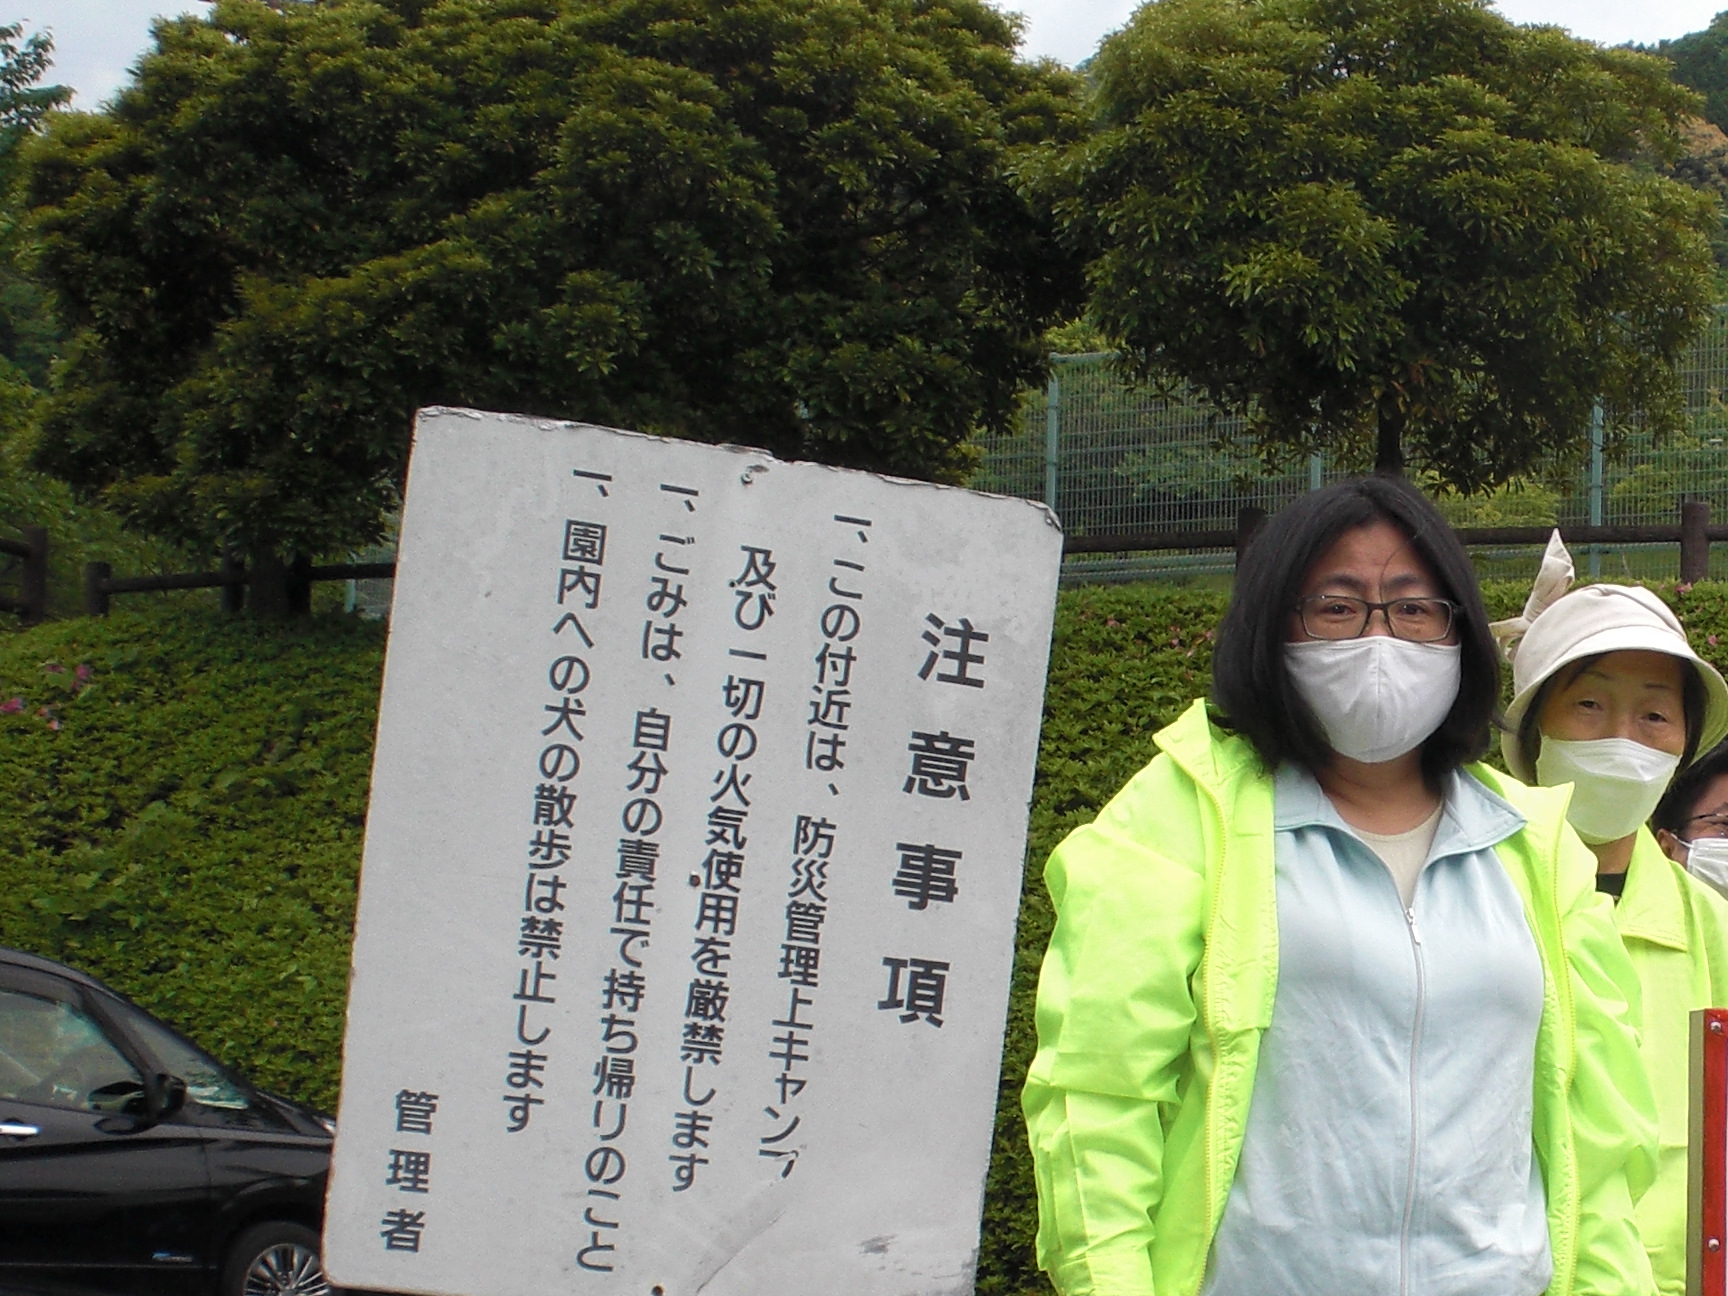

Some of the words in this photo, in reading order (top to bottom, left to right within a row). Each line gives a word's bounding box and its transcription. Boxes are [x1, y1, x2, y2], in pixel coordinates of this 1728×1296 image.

[877, 613, 990, 1029] 注意事項
[380, 1088, 439, 1254] 管理者
